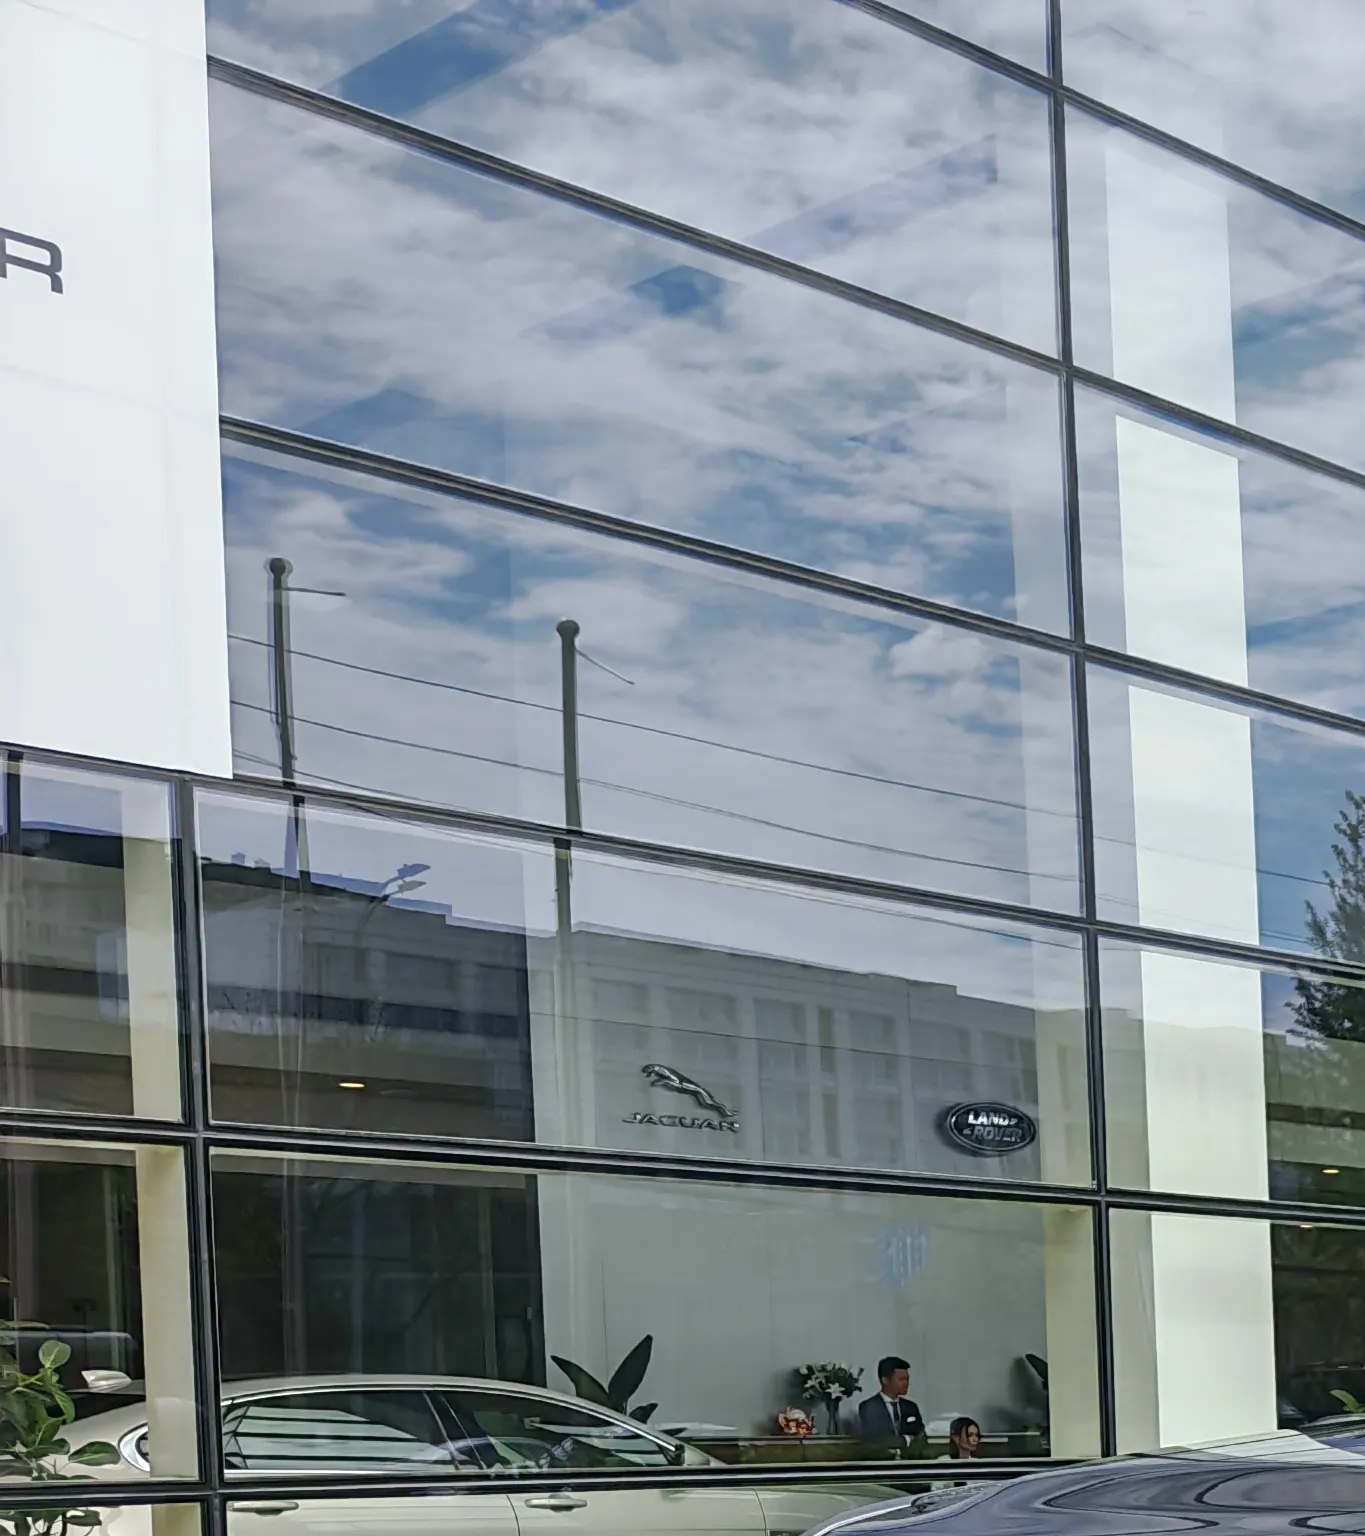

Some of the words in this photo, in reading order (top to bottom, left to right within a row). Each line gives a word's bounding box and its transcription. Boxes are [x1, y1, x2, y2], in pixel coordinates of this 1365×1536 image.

[621, 1111, 740, 1133] JAGUAR
[967, 1110, 1010, 1126] LAND
[971, 1125, 1022, 1143] ROVER
